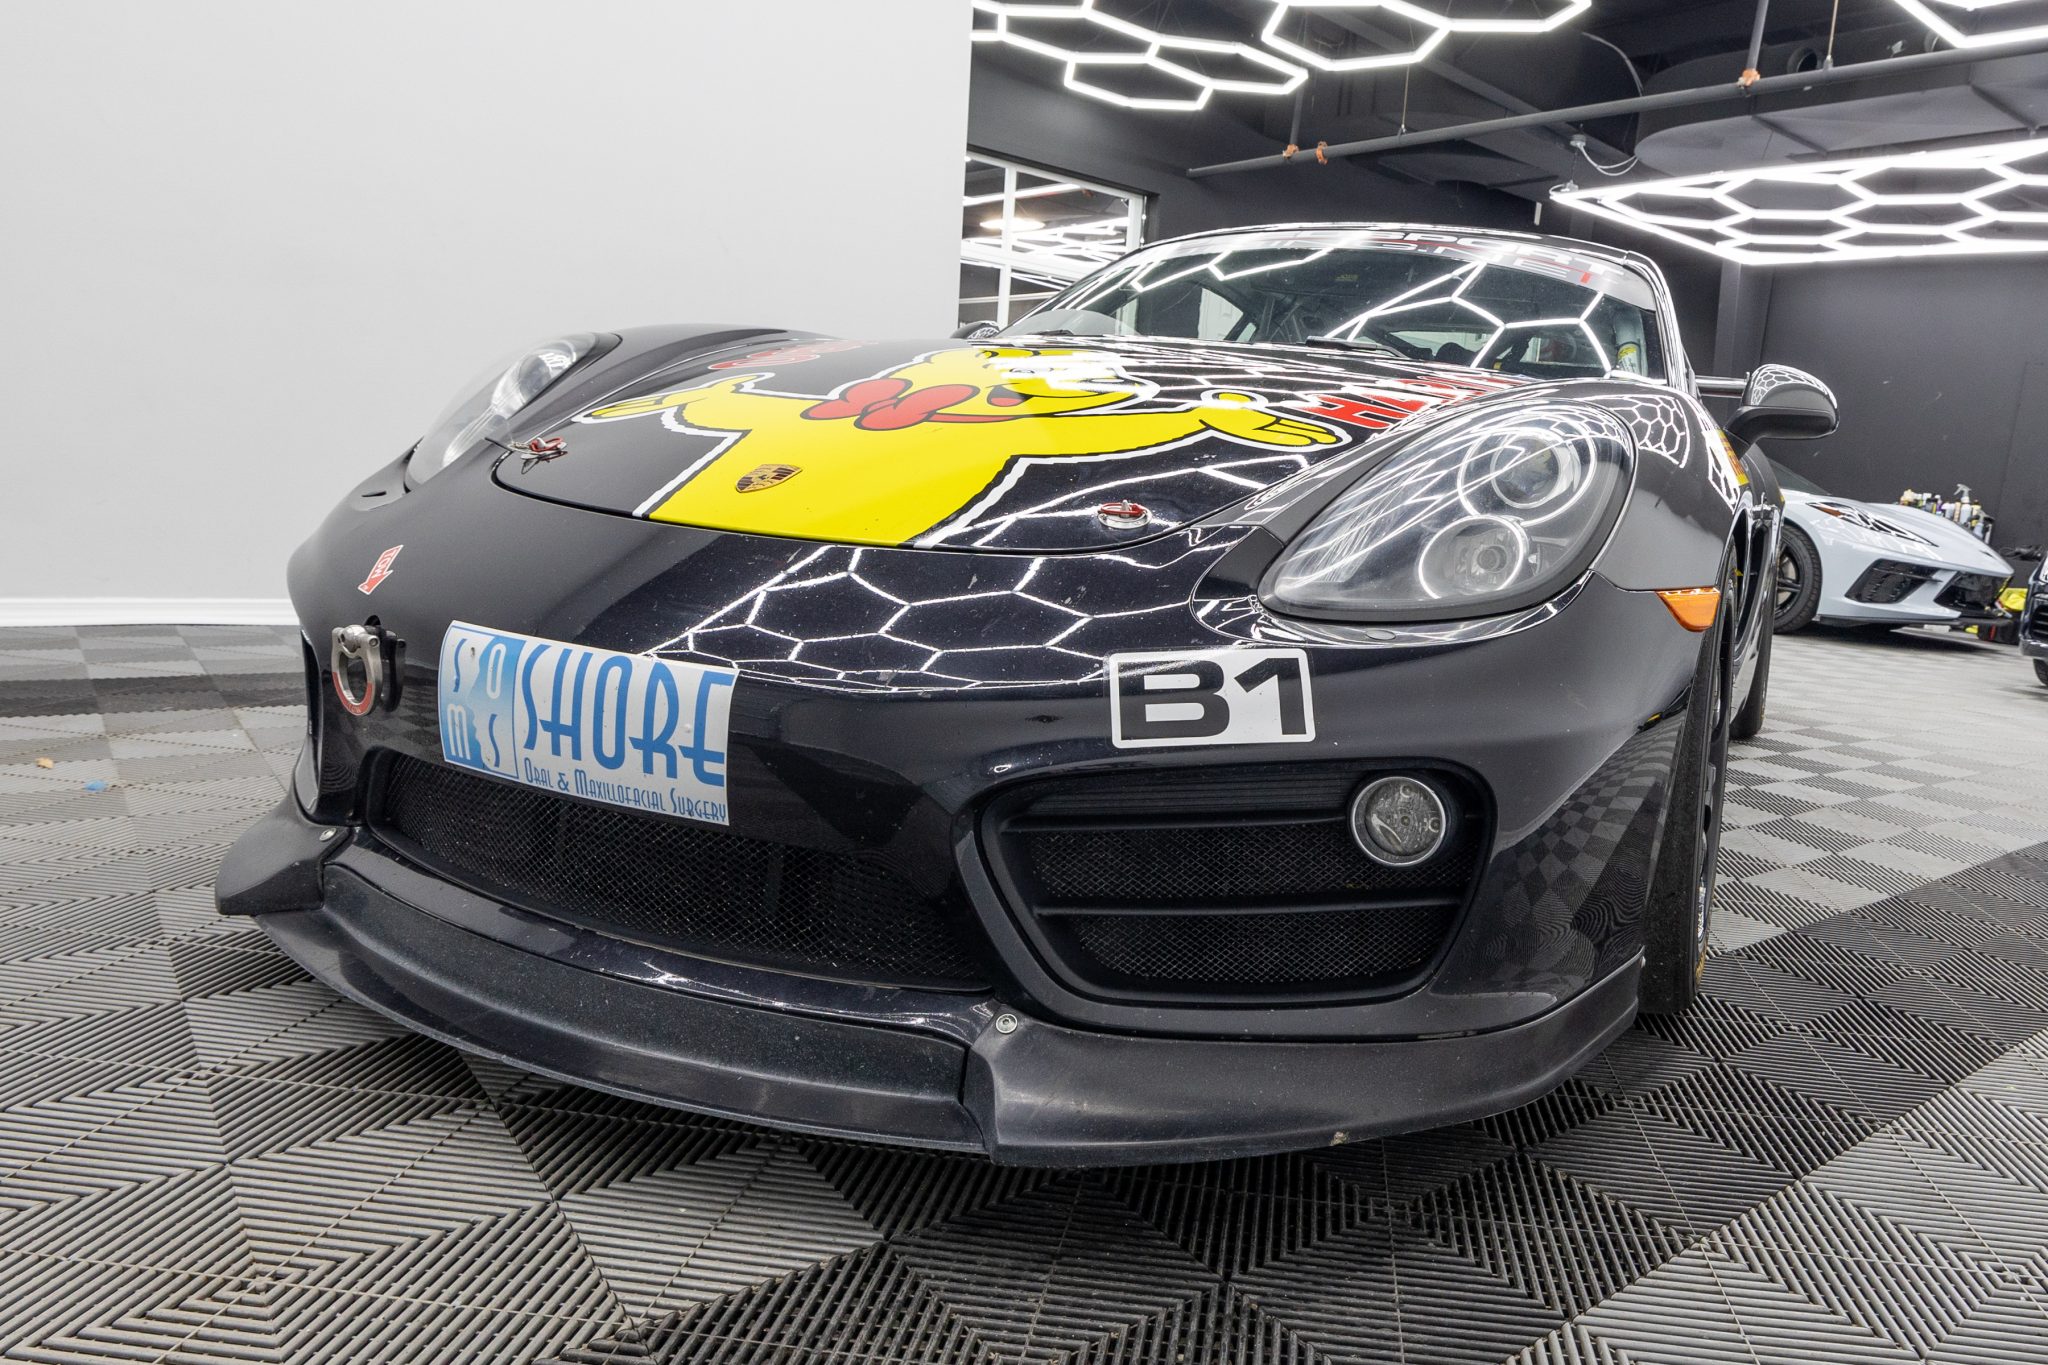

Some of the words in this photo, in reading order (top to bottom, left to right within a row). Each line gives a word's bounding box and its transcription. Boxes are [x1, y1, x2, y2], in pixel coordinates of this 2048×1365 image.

[522, 644, 735, 787] SHORE
[1117, 657, 1307, 741] B1
[557, 772, 570, 793] &
